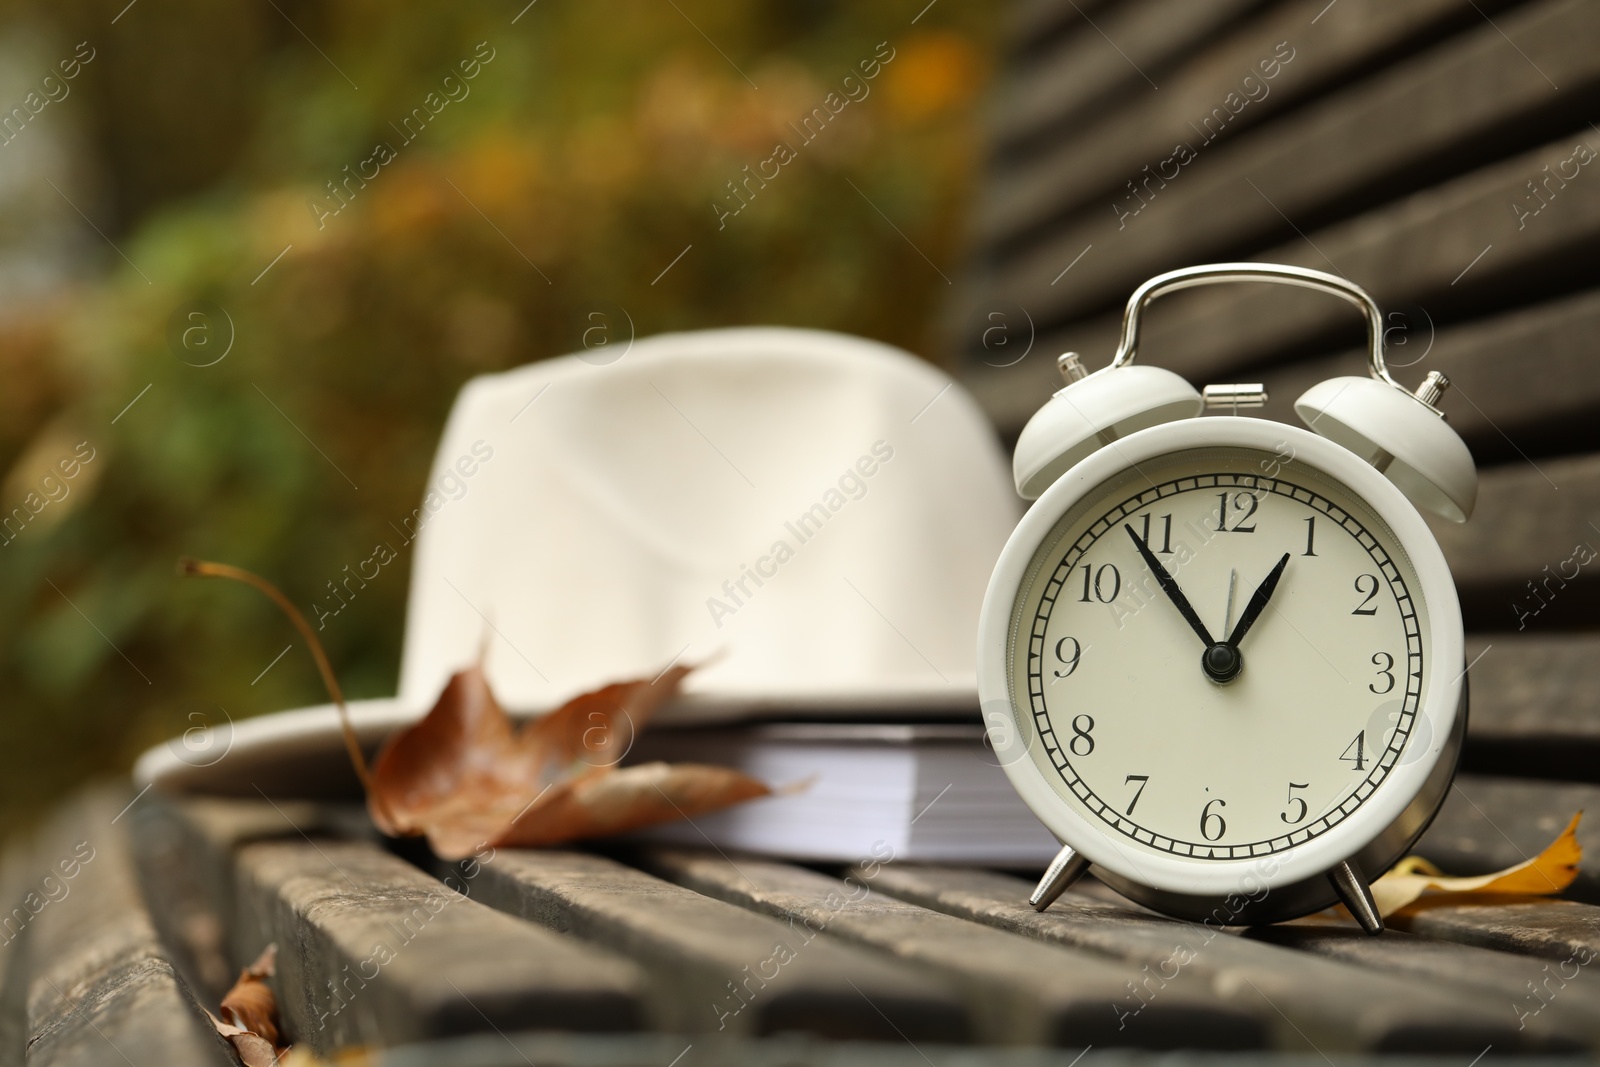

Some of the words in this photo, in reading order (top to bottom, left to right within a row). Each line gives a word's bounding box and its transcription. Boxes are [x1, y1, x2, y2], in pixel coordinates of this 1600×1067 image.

[1136, 512, 1175, 554] 11
[1213, 491, 1259, 533] 12
[1300, 516, 1319, 557] 1
[1077, 563, 1121, 604] 10
[1351, 573, 1380, 616] 2
[1054, 636, 1081, 678] 9
[1368, 652, 1395, 694] 3
[1069, 714, 1095, 756] 8
[1339, 729, 1369, 771] 4
[1124, 775, 1150, 816] 7
[1280, 782, 1309, 824] 5
[1200, 799, 1226, 841] 6
